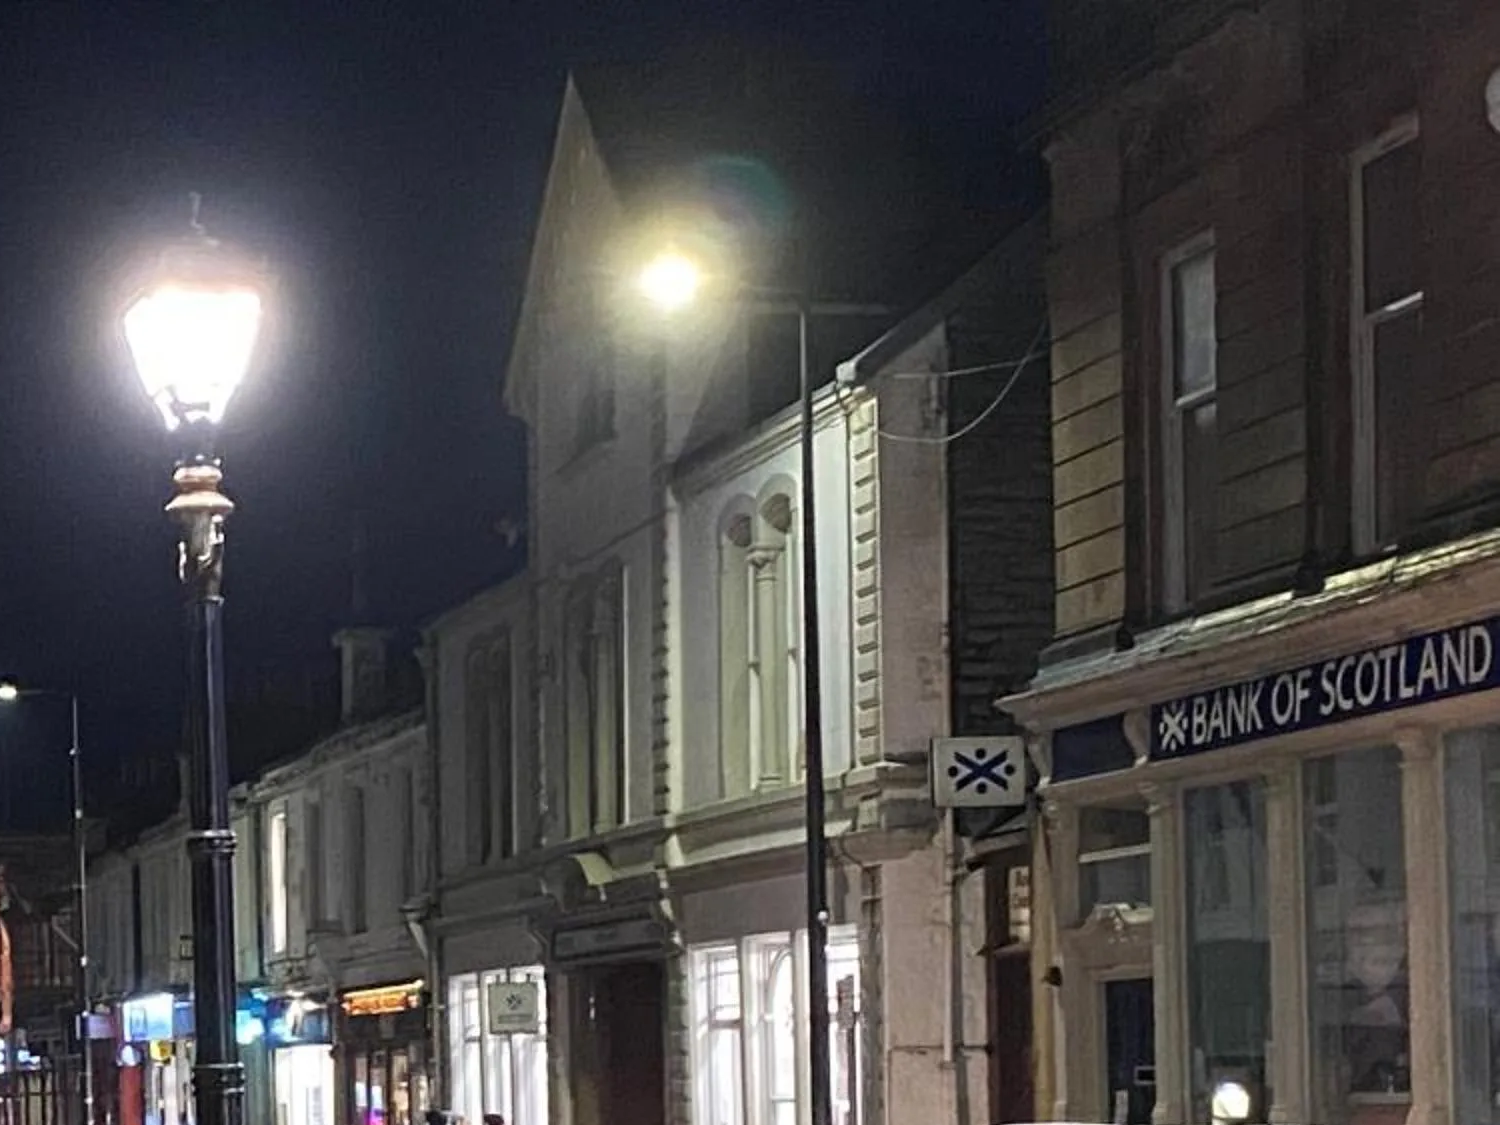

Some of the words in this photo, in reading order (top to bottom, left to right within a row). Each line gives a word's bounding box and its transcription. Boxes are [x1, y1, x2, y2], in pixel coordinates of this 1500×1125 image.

[1191, 679, 1264, 745] BANK
[1271, 671, 1311, 726] OF
[1320, 624, 1493, 717] SCOTLAND
